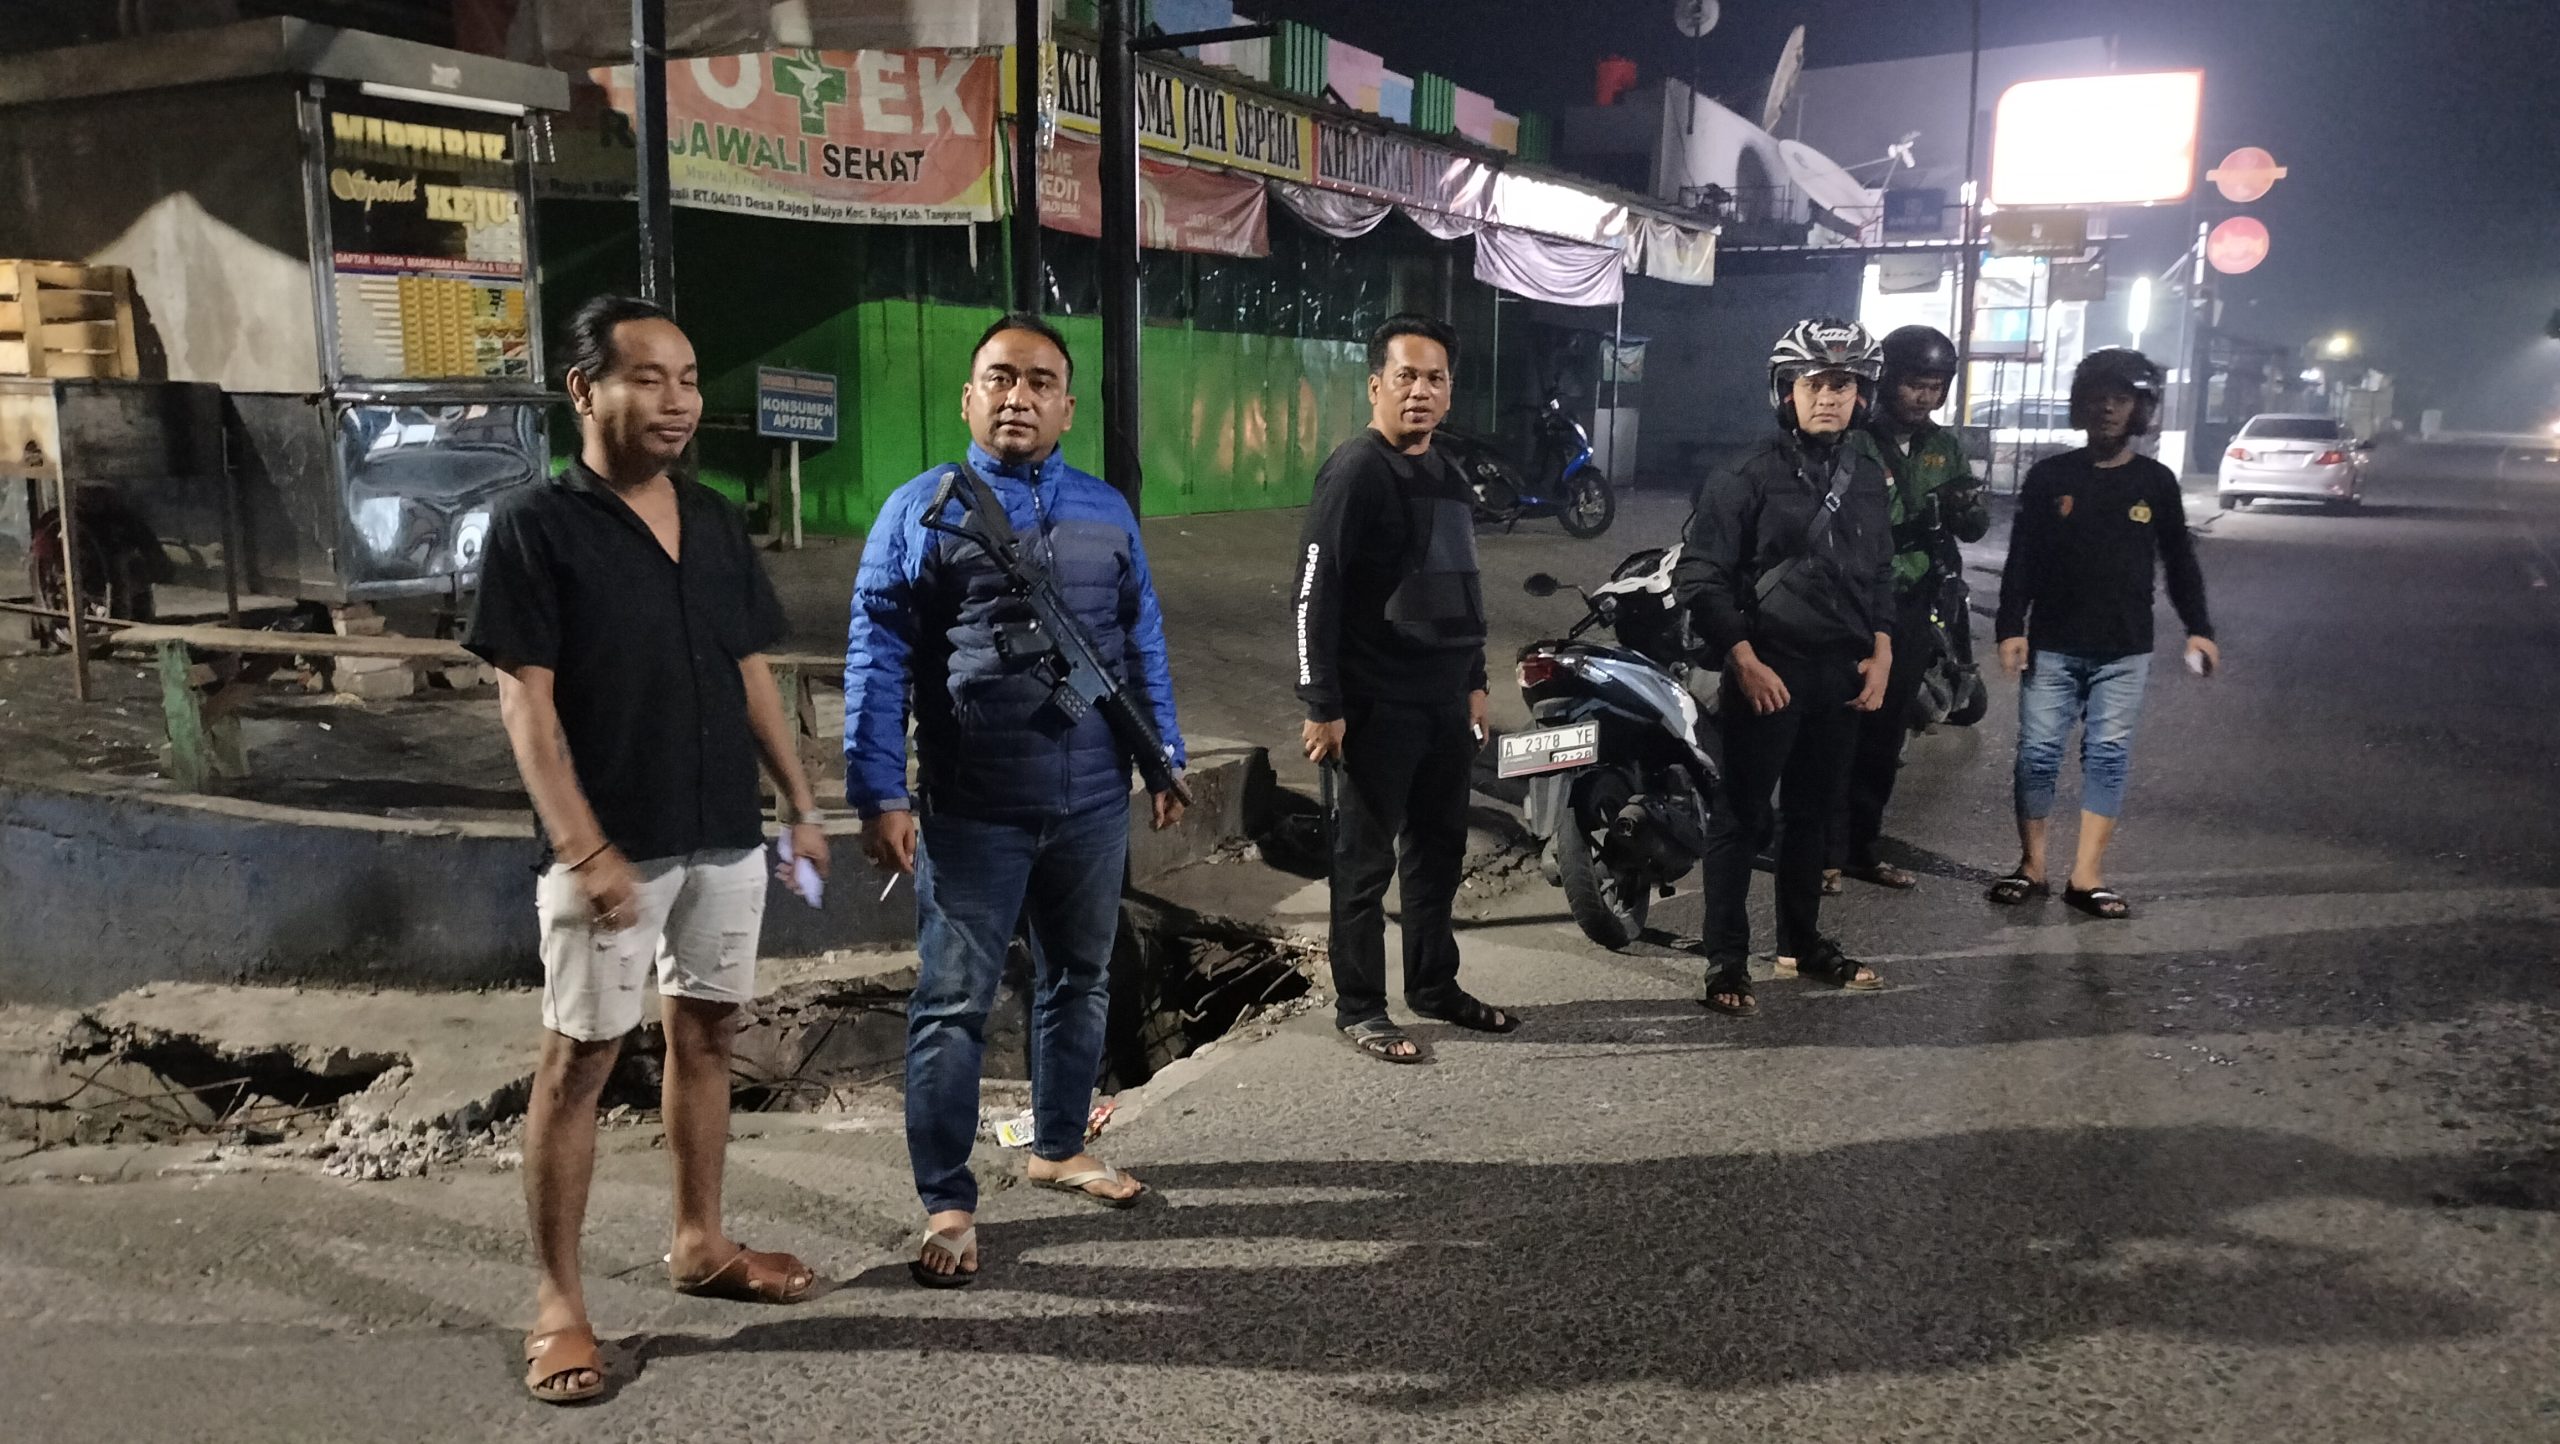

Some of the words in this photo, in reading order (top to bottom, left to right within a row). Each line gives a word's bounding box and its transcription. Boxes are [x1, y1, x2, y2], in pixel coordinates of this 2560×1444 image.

[600, 110, 808, 176] RJAWALI
[822, 141, 924, 183] SEHAT
[1182, 82, 1227, 152] JAYA
[1235, 97, 1300, 172] SEPEDA
[1319, 121, 1414, 197] KHARISMA
[424, 184, 508, 231] KEJU
[745, 195, 774, 211] Desa
[777, 198, 809, 216] Rajeg
[335, 252, 371, 265] DAFTAR
[762, 396, 833, 417] KONSUMEN
[773, 412, 823, 431] APOTEK
[1300, 543, 1320, 599] OPSNAL
[1297, 601, 1311, 686] TANGERANG
[1505, 742, 1514, 758] A
[1526, 733, 1561, 753] 2378
[1576, 728, 1593, 744] YE
